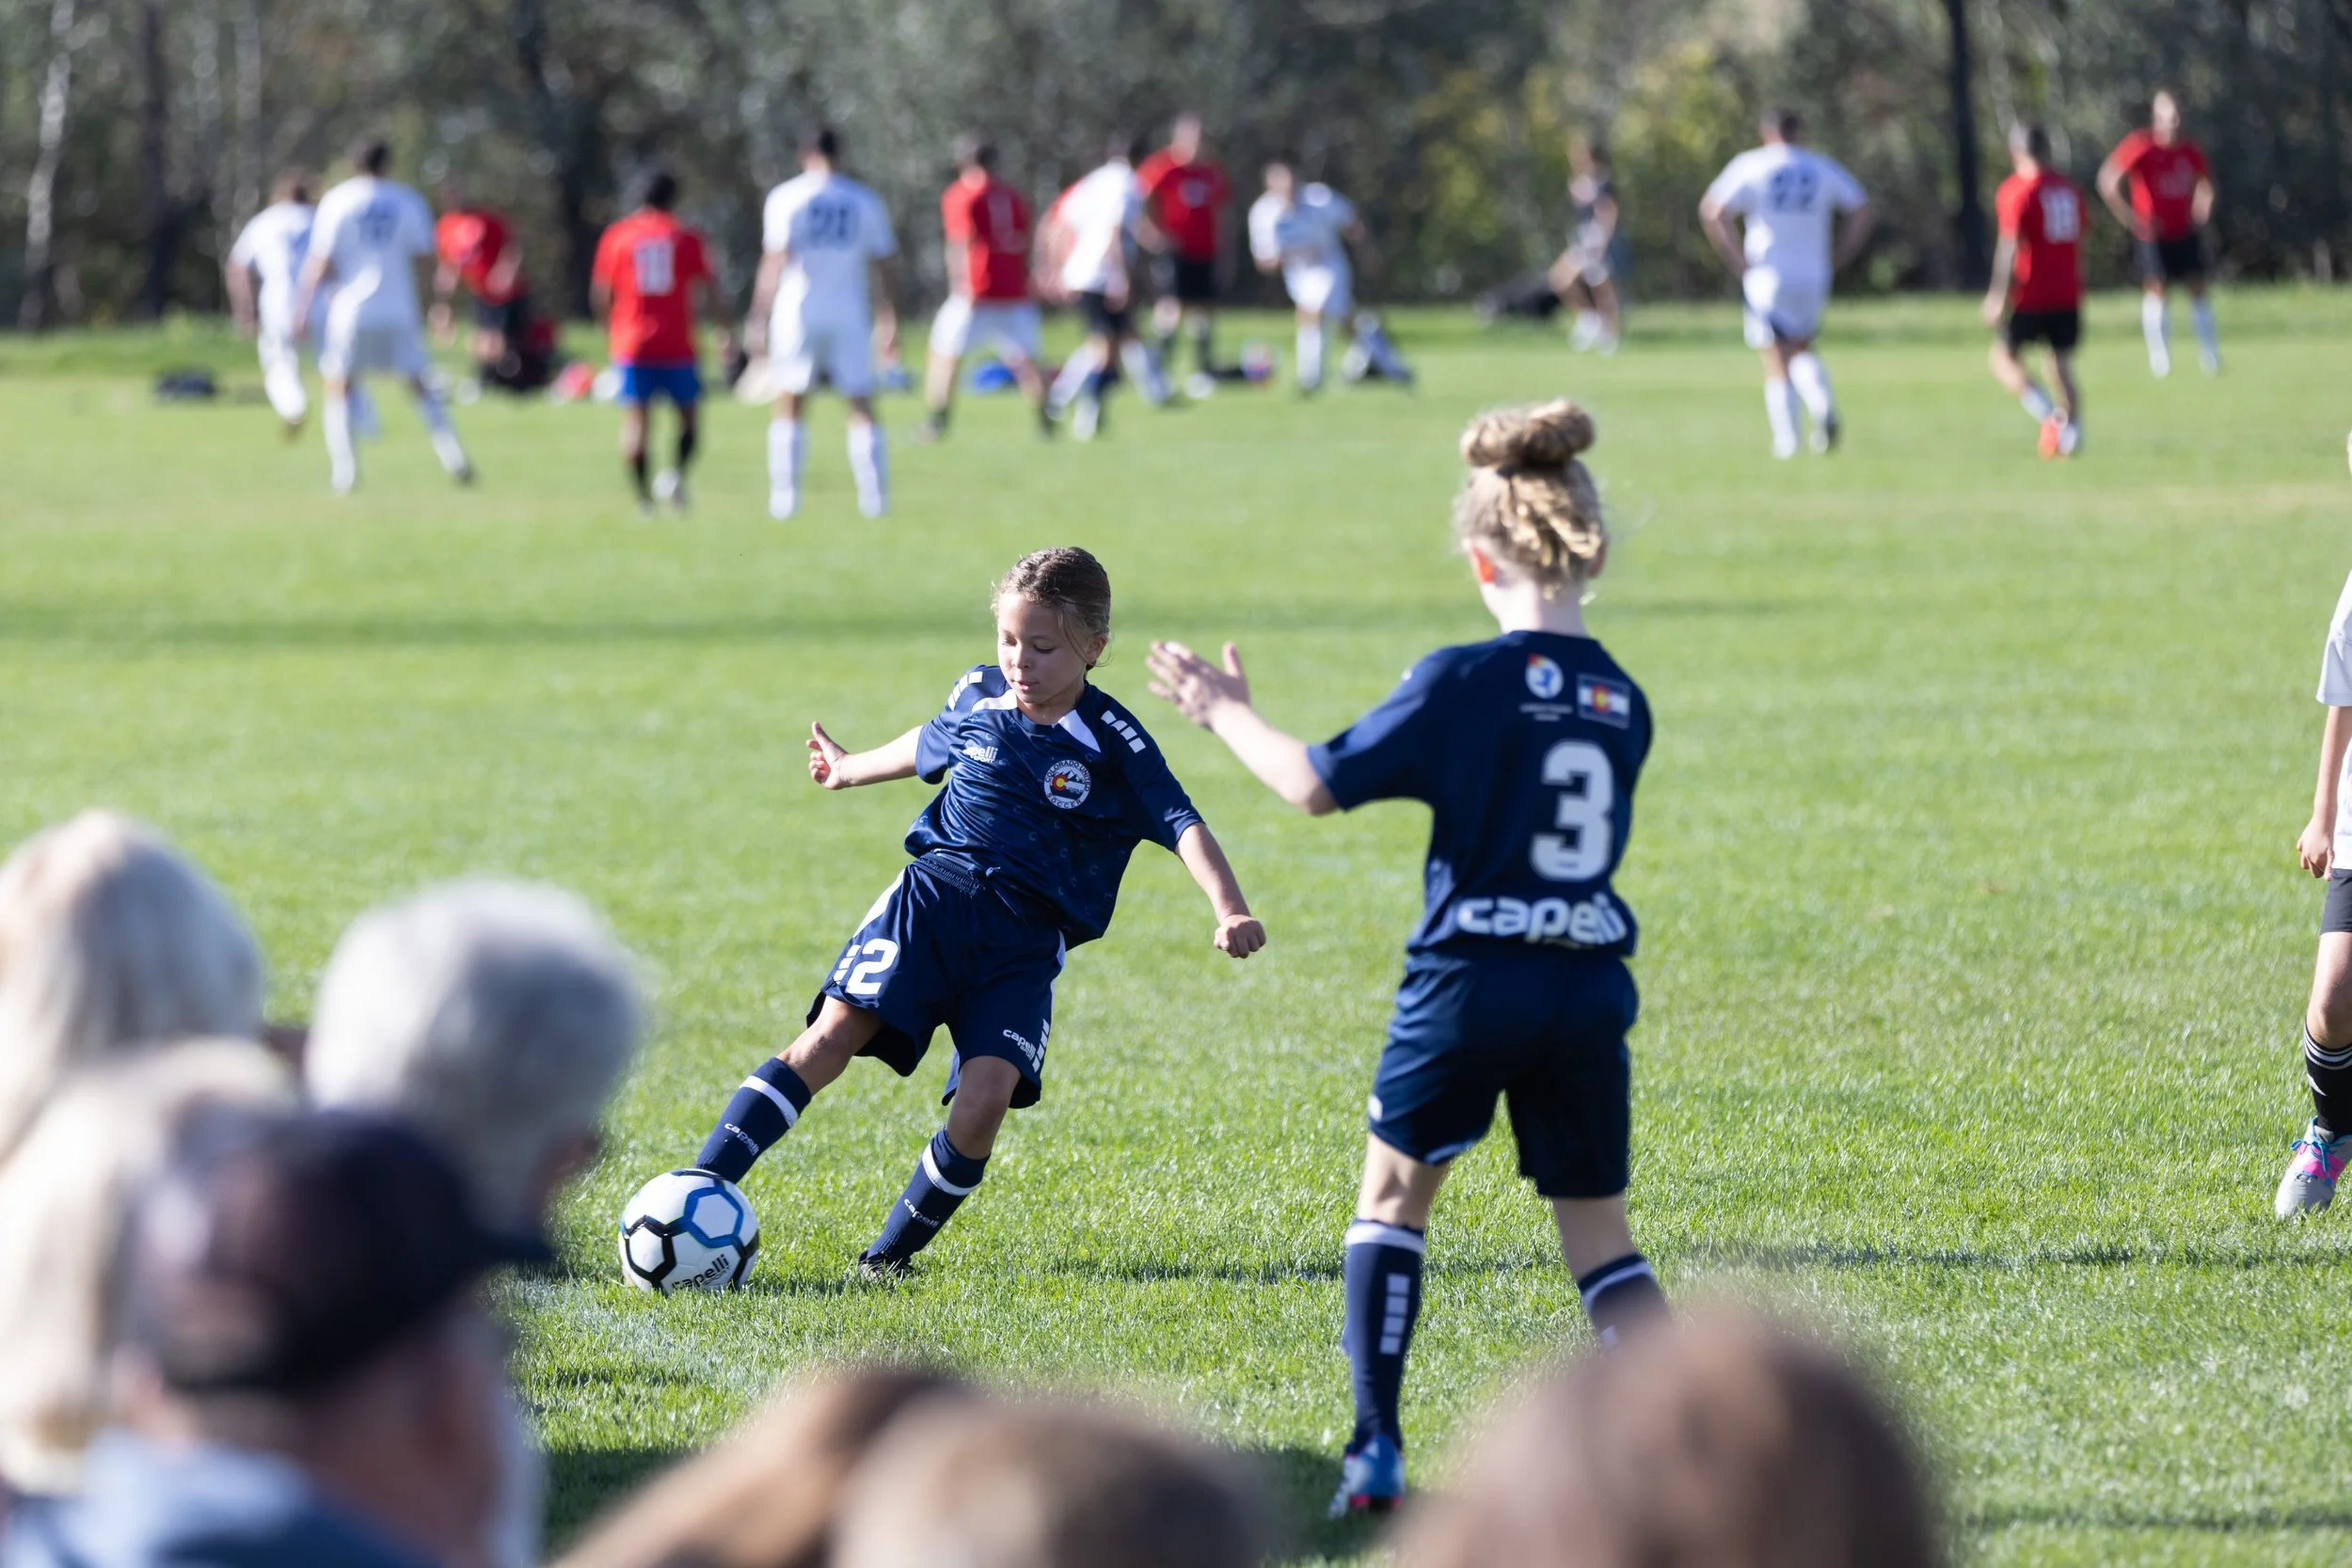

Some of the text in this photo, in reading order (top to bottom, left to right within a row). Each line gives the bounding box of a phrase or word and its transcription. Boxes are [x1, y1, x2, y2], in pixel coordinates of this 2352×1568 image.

[1045, 761, 1090, 792] COLORADO UNITED
[1046, 792, 1082, 809] SOCCER
[1528, 738, 1614, 882] 3
[845, 938, 899, 995] 2
[1003, 1029, 1036, 1058] capelli
[724, 1123, 759, 1154] capelli
[904, 1198, 940, 1227] capelli
[672, 1254, 729, 1290] capelli
